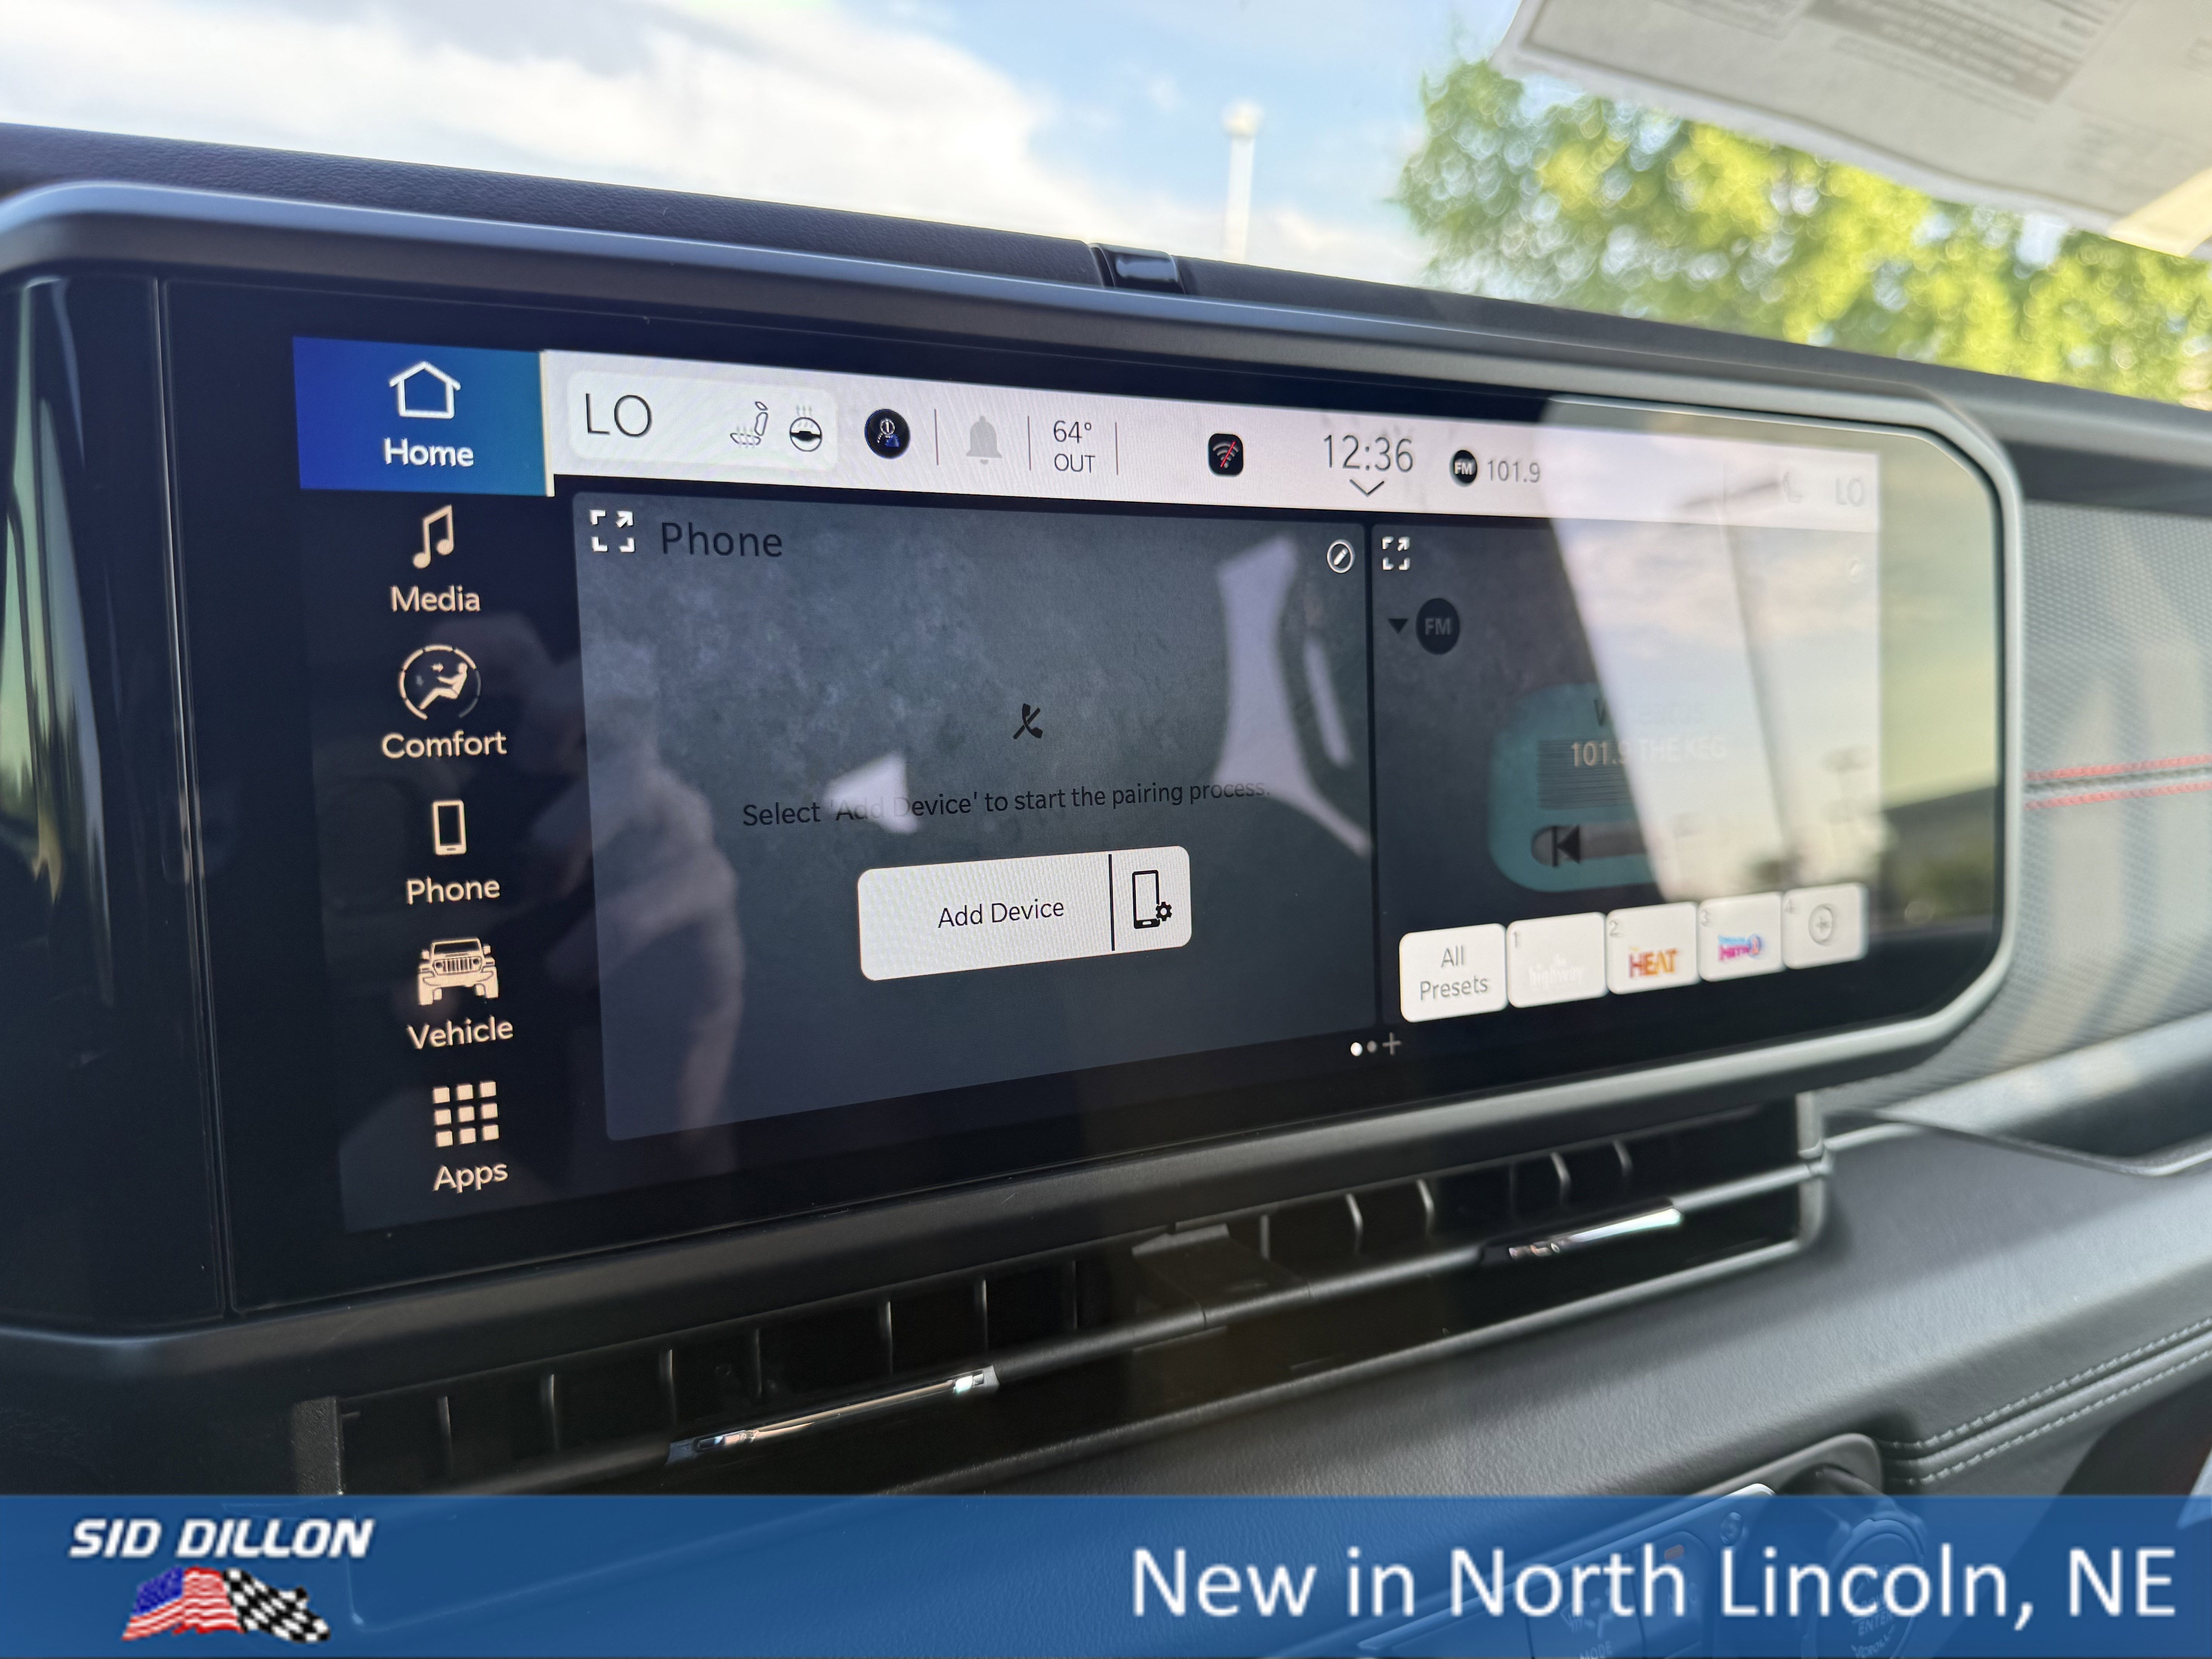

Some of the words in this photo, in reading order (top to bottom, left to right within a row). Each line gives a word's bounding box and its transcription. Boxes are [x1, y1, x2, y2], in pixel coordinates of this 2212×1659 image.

[585, 392, 653, 438] LO
[1053, 420, 1092, 444] 64°
[383, 437, 475, 467] Home
[1054, 453, 1096, 473] OUT
[1324, 433, 1414, 473] 12:36
[1454, 461, 1473, 476] FM
[1487, 459, 1540, 483] 101.9
[1835, 476, 1866, 507] LO
[661, 522, 783, 558] Phone
[389, 585, 481, 613] Media
[1424, 618, 1452, 635] FM
[381, 729, 507, 759] Comfort
[742, 801, 822, 827] Select
[985, 792, 1009, 813] to
[1014, 788, 1066, 811] start
[1072, 785, 1106, 807] the
[1112, 782, 1183, 809] pairing
[405, 876, 501, 905] Phone
[938, 903, 984, 928] Add
[991, 898, 1065, 923] Device
[1609, 919, 1623, 938] 2
[1440, 945, 1464, 968] All
[1628, 948, 1678, 979] HEAT
[1420, 975, 1489, 1001] Presets
[406, 1015, 514, 1050] Vehicle
[432, 1162, 508, 1194] Apps
